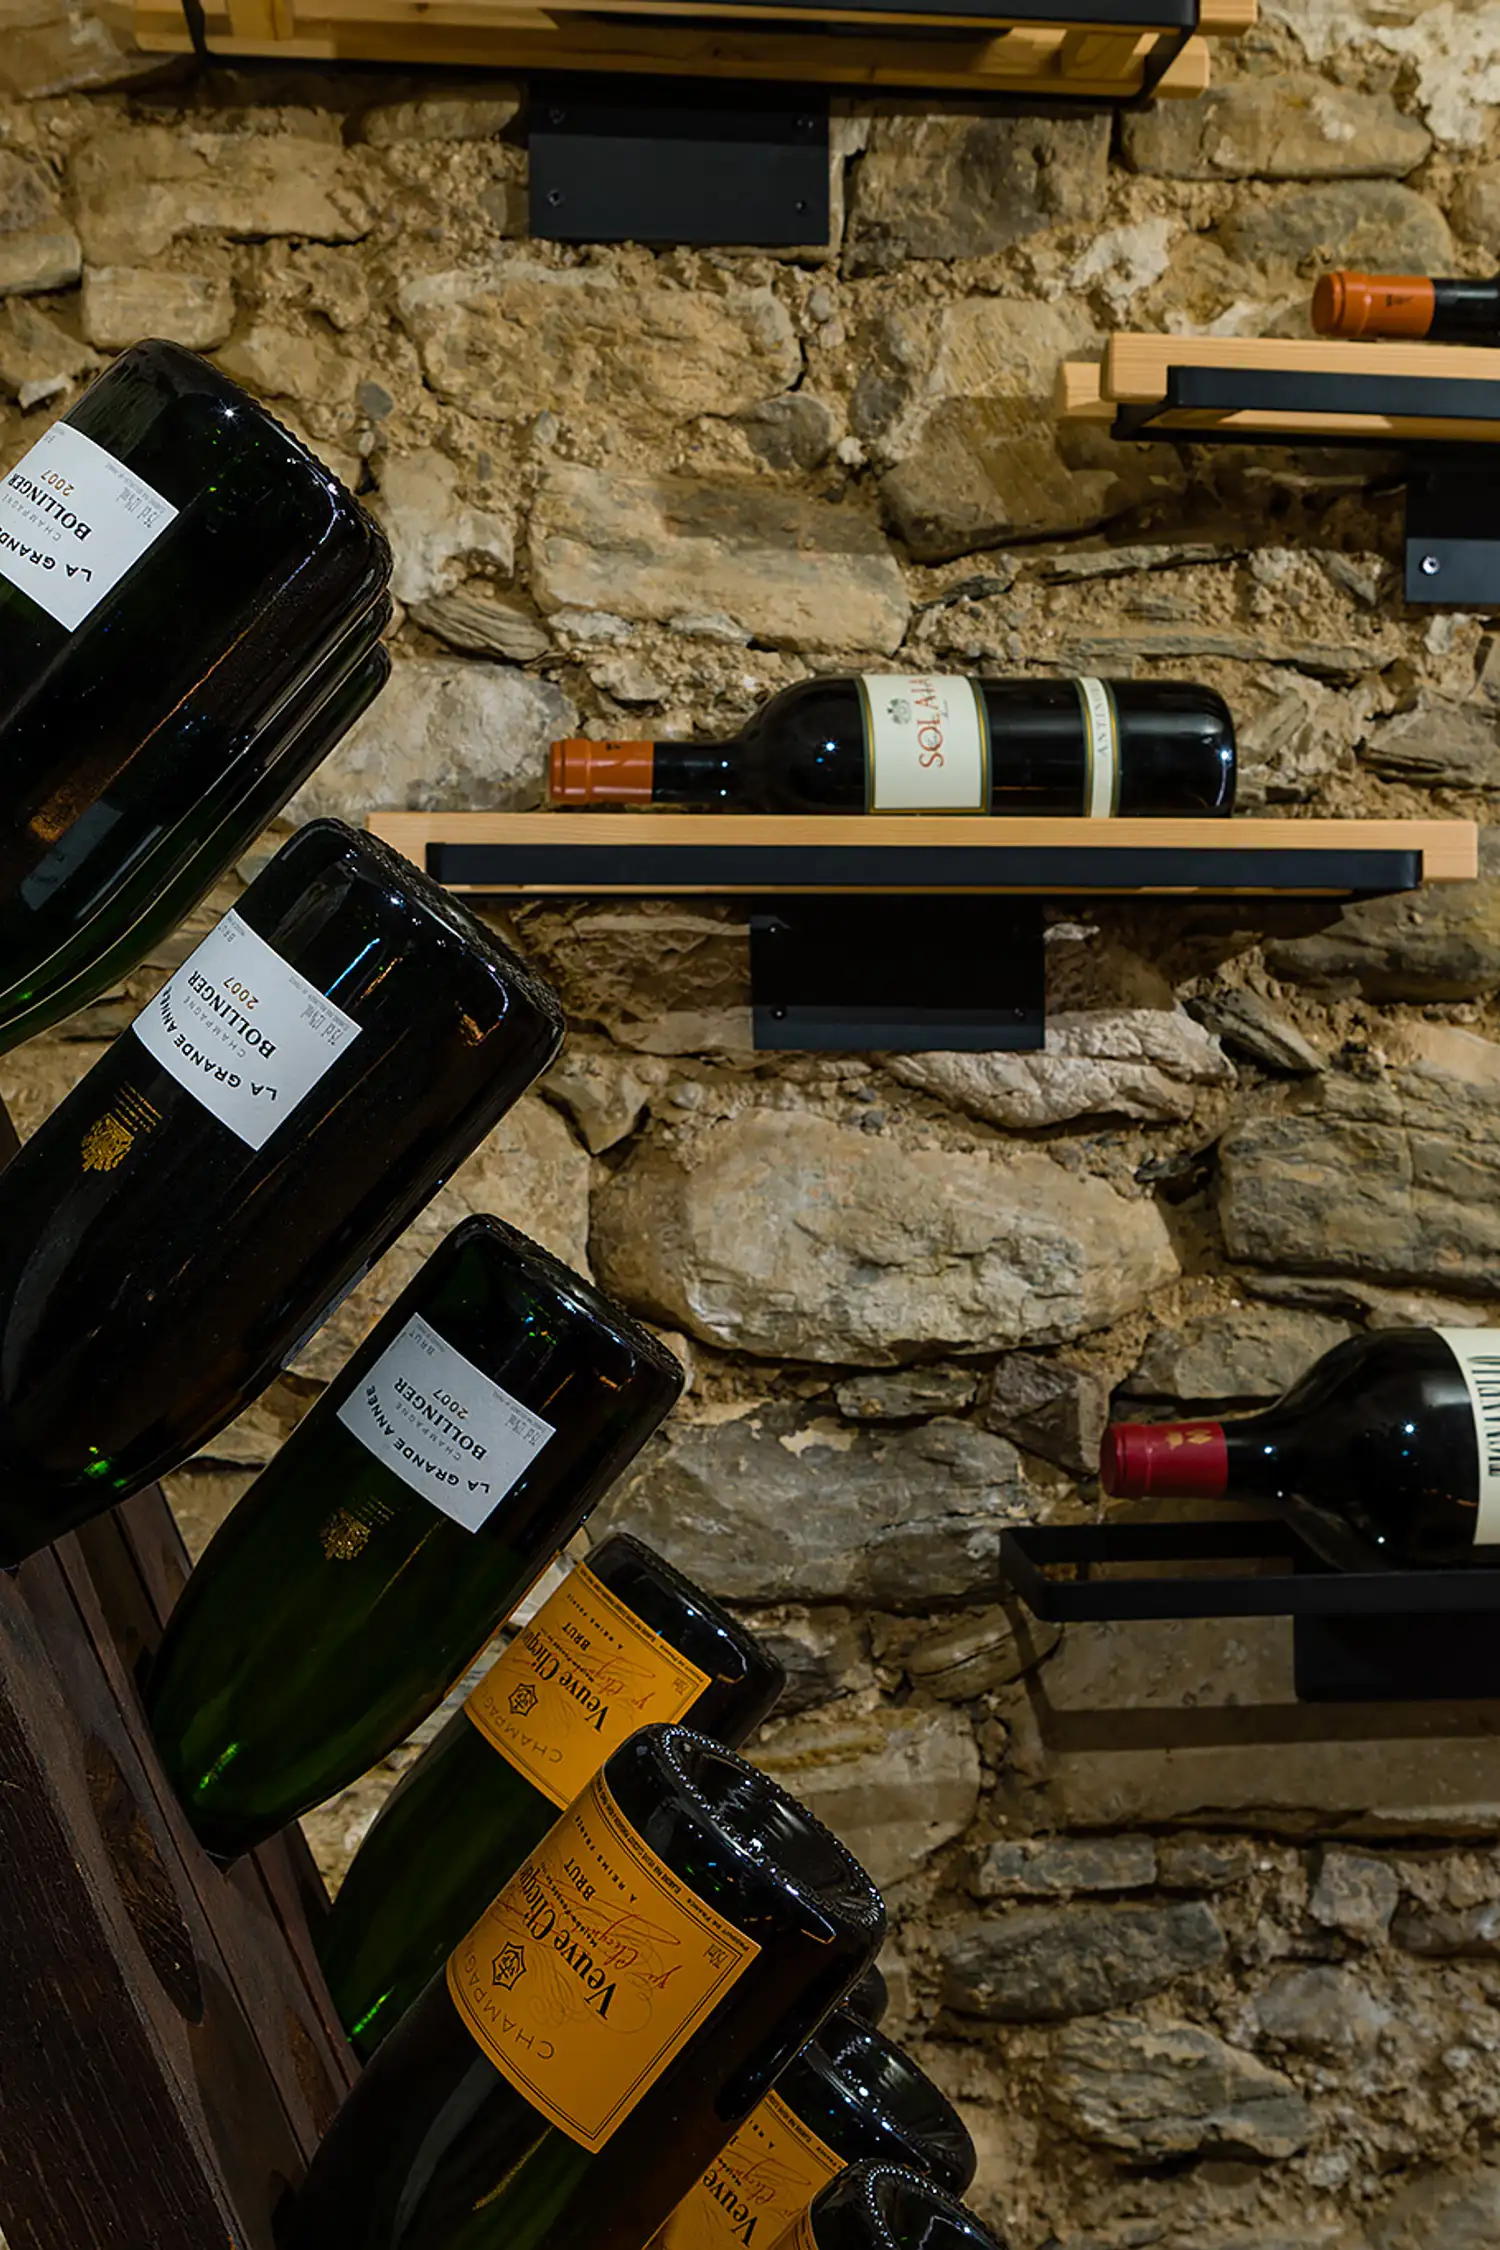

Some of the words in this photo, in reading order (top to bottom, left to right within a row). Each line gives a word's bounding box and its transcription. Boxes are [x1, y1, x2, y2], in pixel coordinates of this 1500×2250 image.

[41, 470, 74, 497] 2007
[8, 473, 92, 541] BOLLINGER
[0, 527, 56, 570] GRAND
[65, 563, 93, 583] LA
[186, 970, 276, 1059] BOLLINGER
[222, 975, 259, 1009] 2007
[182, 994, 246, 1057] CHAMPAGNE
[172, 1033, 240, 1087] GRANDE
[251, 1082, 276, 1101] LA
[408, 1329, 435, 1355] BRUT
[392, 1376, 487, 1460] BOLLINGER
[432, 1387, 469, 1419] 2007
[393, 1401, 462, 1461] CHAMPAGNE
[392, 1437, 459, 1486] GRANDE
[466, 1481, 491, 1494] LA
[561, 1622, 590, 1651] BRUT
[558, 1671, 607, 1732] Veuve
[574, 1815, 594, 1851] FRANCE
[563, 1856, 595, 1901] BRUT
[595, 1854, 625, 1890] REIMS
[518, 1865, 556, 1938] Clicqu
[552, 1930, 615, 2020] Veuve
[699, 2169, 757, 2247] Veuve
